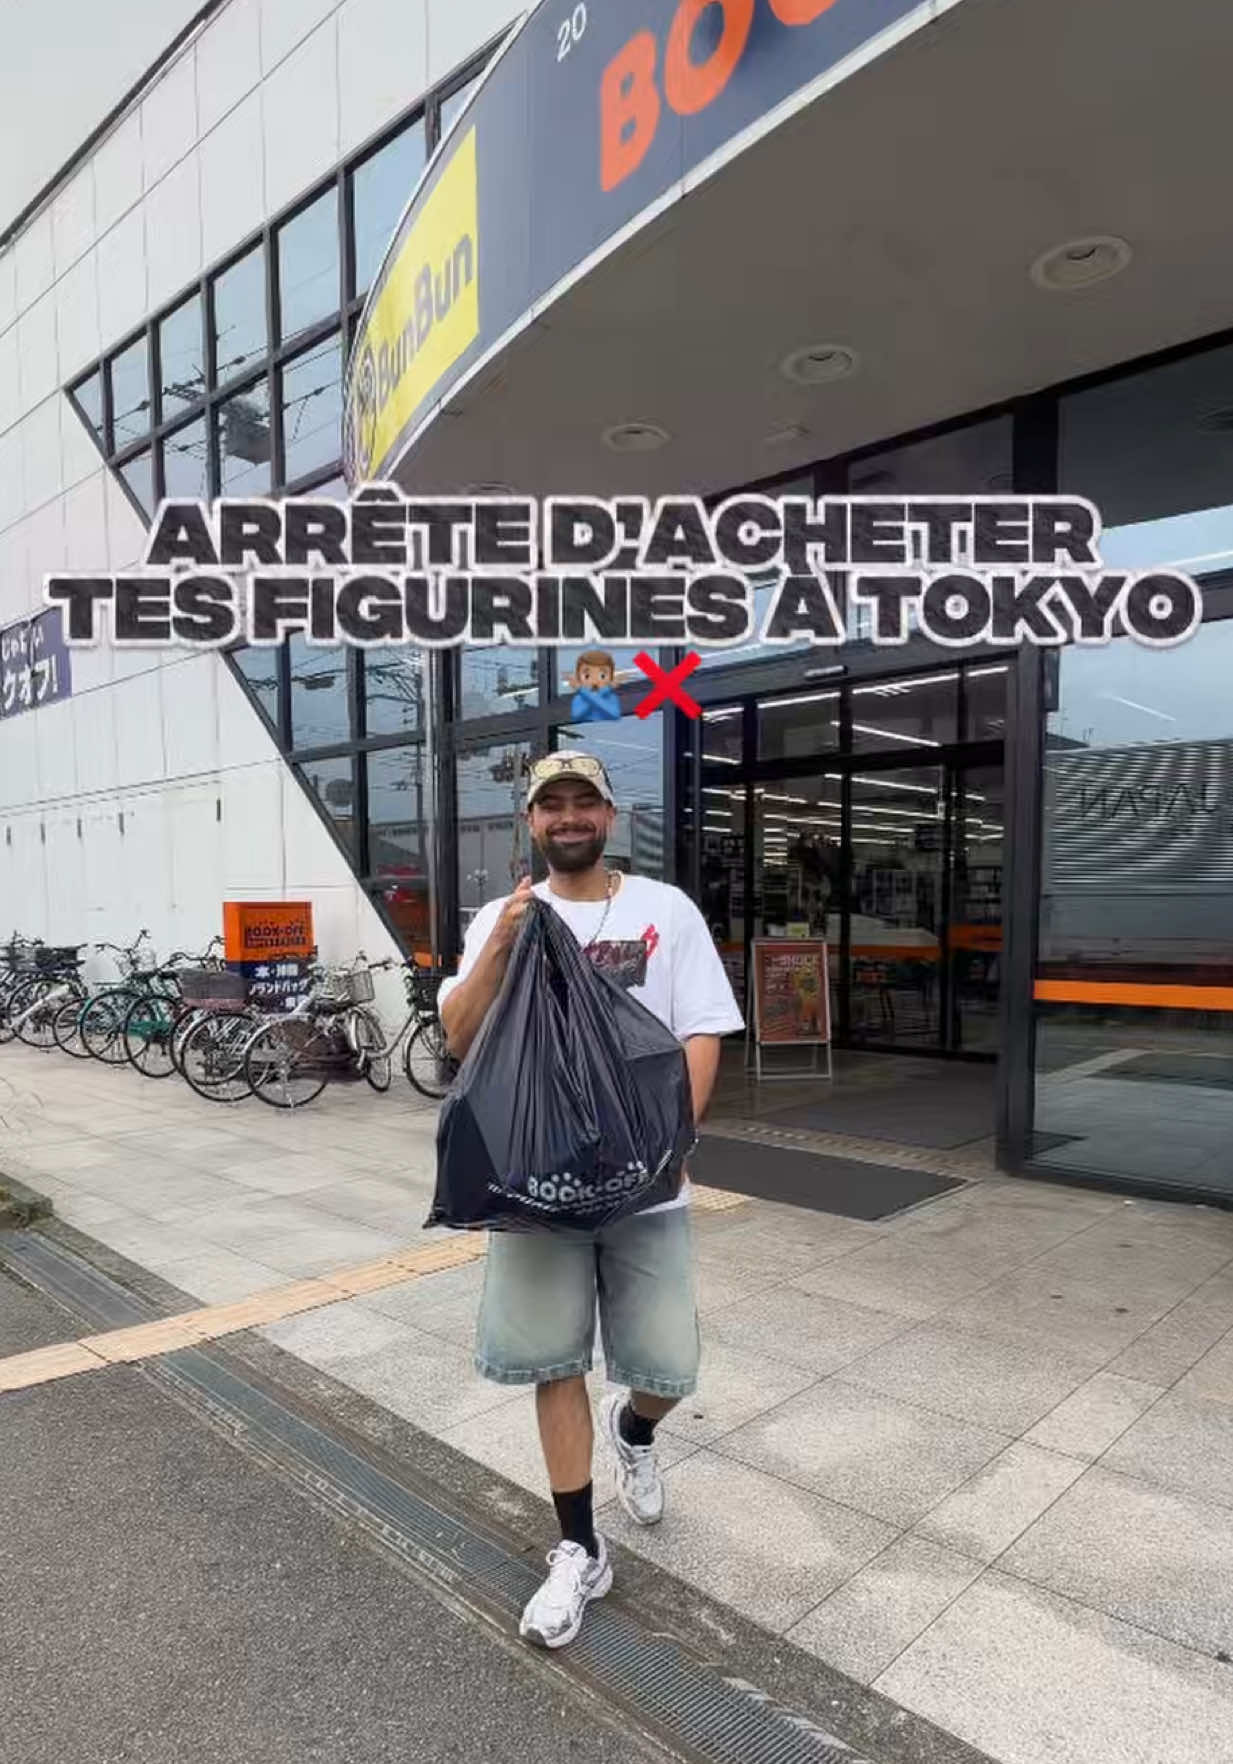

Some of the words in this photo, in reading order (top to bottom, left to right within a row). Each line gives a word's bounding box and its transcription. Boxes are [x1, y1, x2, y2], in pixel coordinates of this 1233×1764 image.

[557, 2, 587, 62] 20
[601, 0, 843, 192] BO
[378, 233, 473, 412] BunBun
